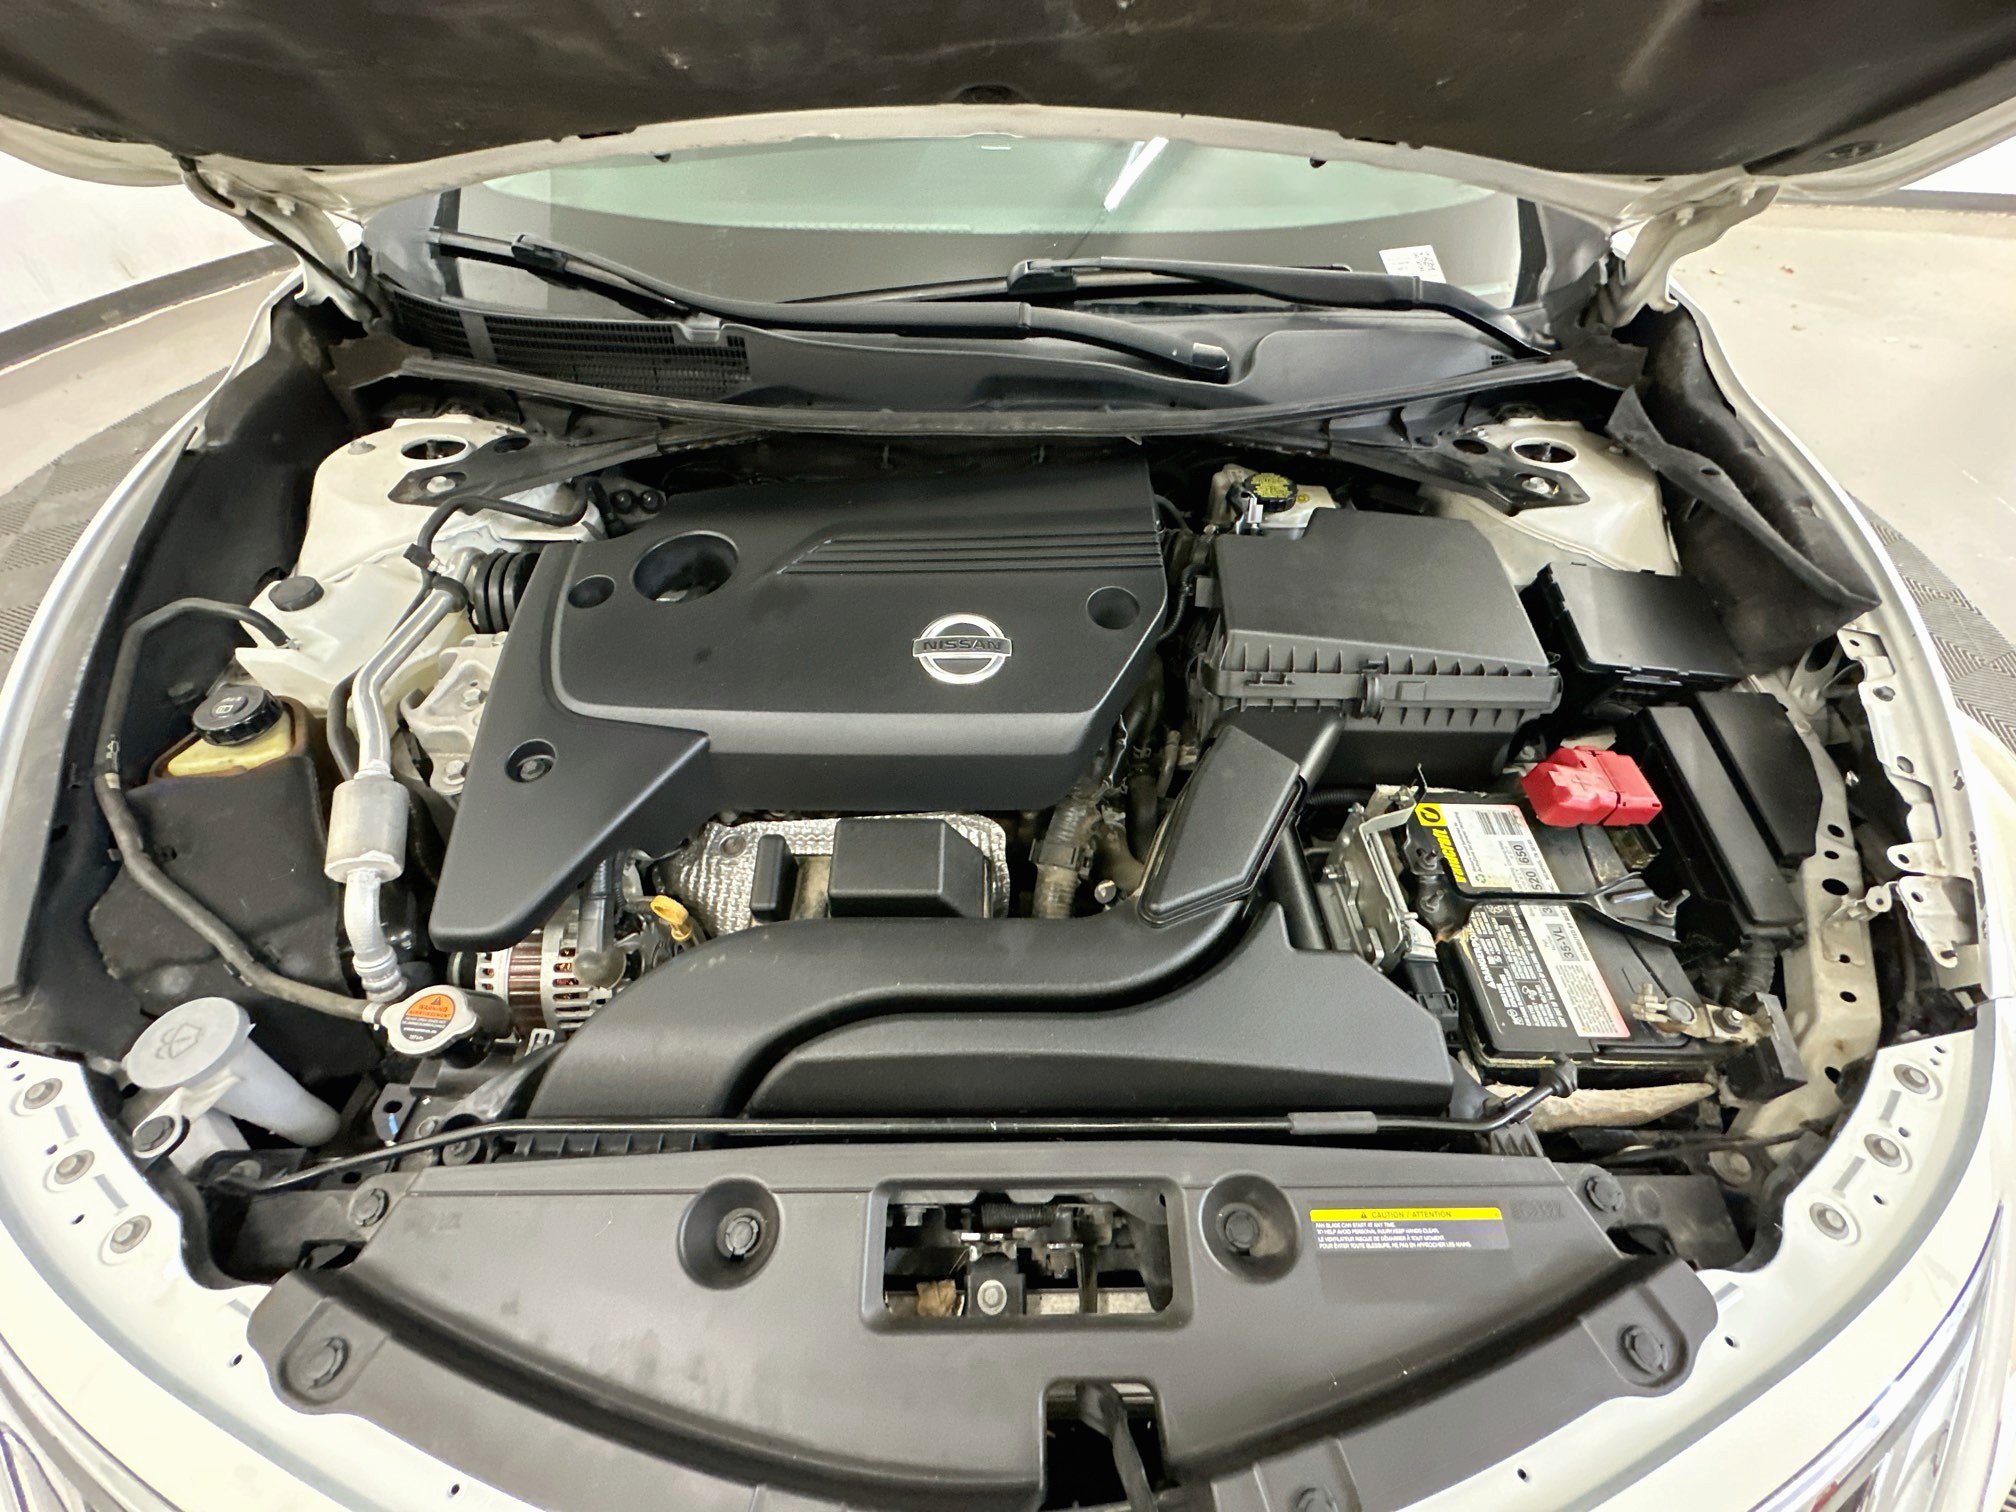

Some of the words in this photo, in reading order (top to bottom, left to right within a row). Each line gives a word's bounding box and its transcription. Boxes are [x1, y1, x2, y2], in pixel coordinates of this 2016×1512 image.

[923, 639, 1001, 650] NISSAN
[1514, 844, 1528, 864] 650
[1526, 871, 1543, 891] 520
[1552, 928, 1574, 959] 35-VL
